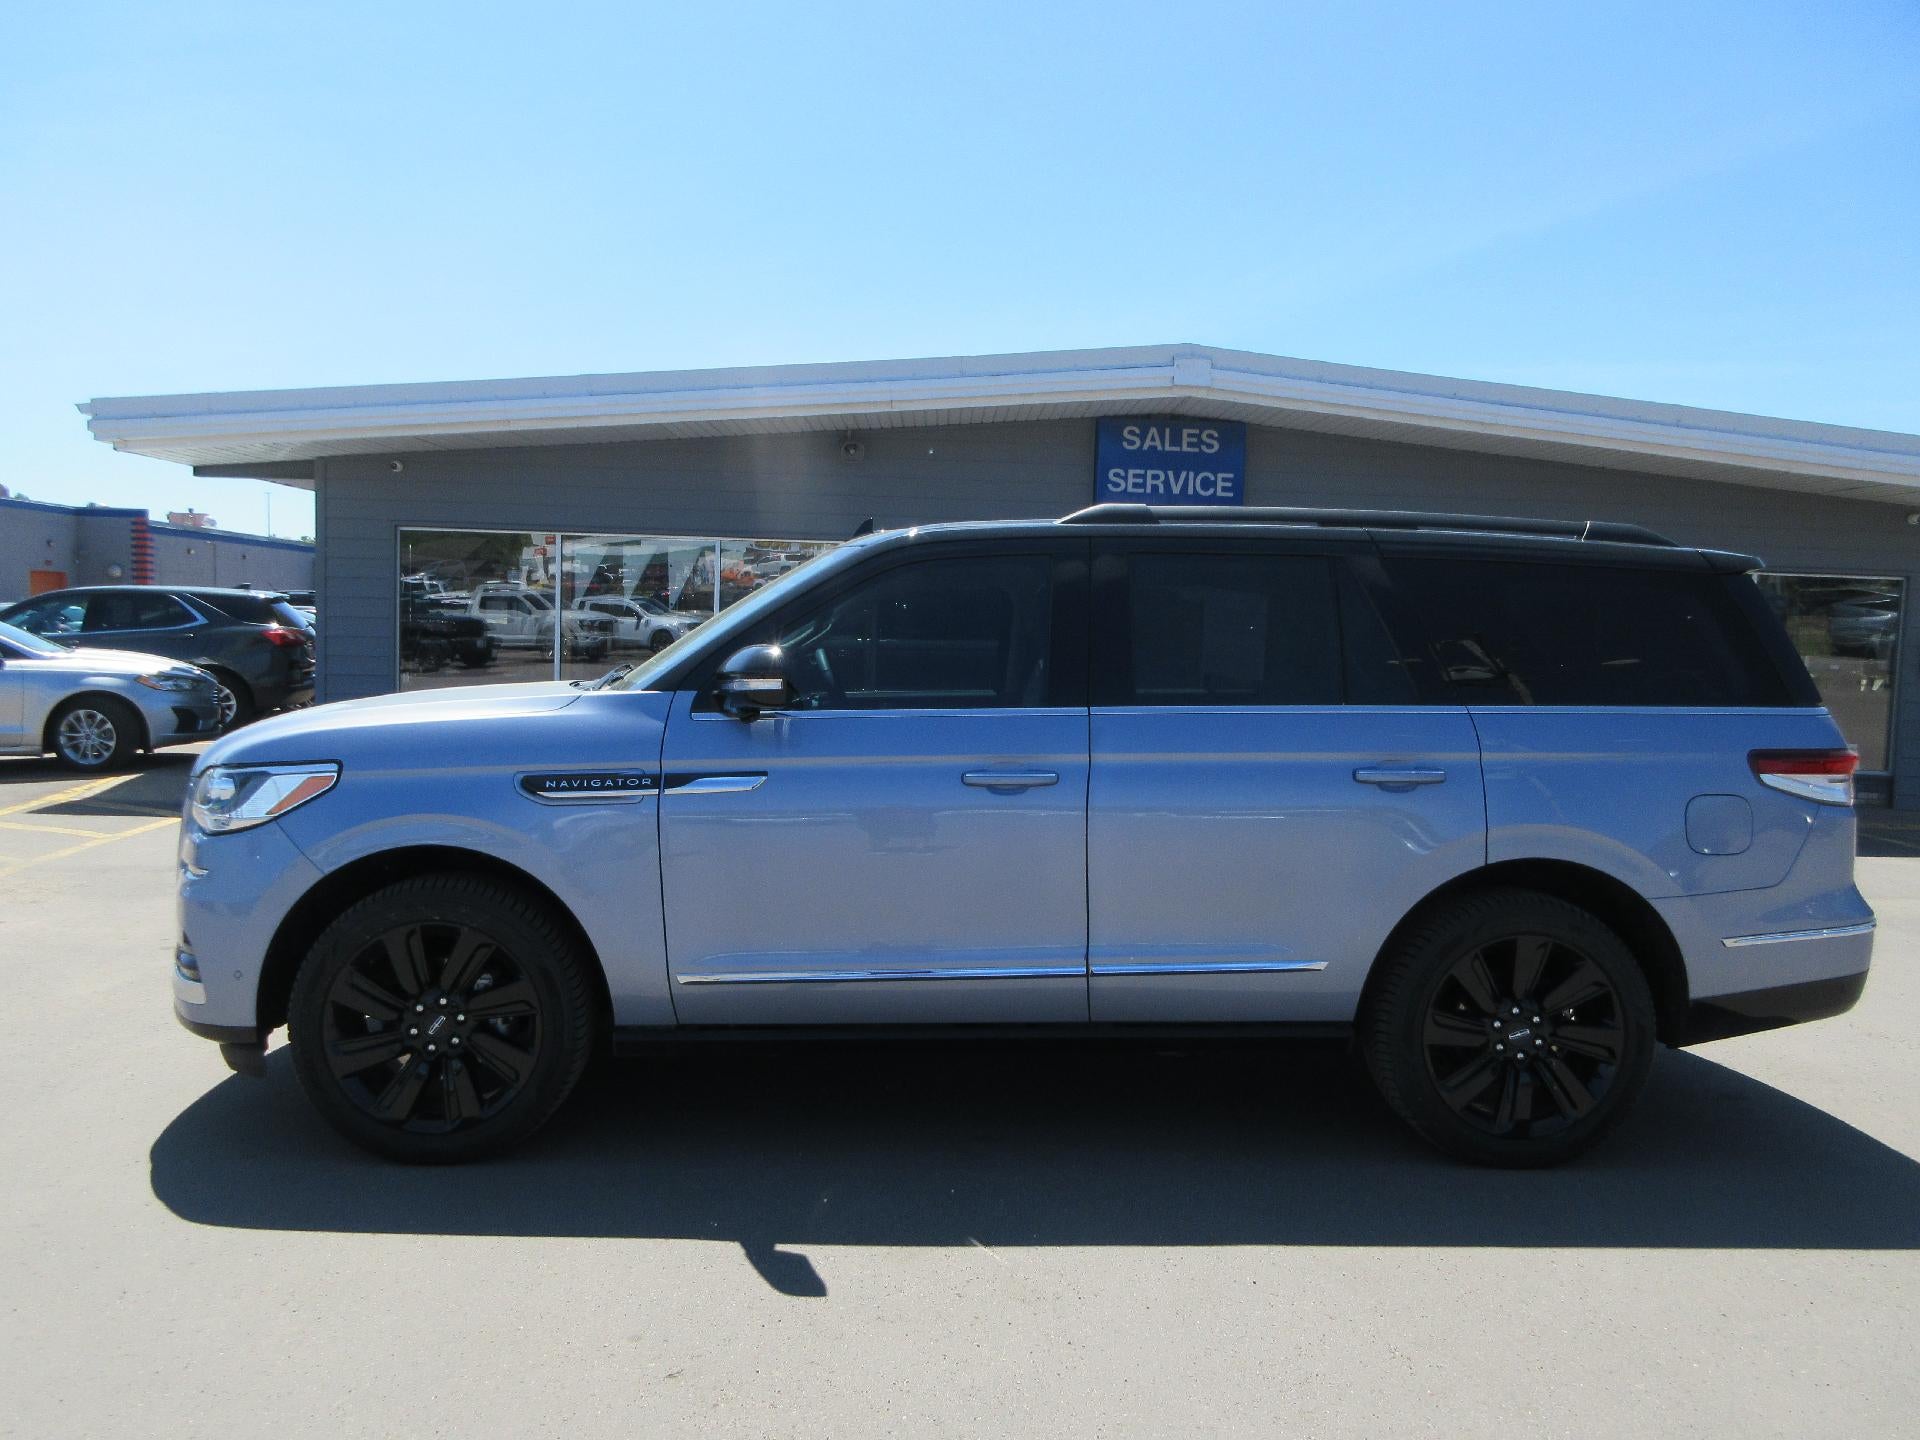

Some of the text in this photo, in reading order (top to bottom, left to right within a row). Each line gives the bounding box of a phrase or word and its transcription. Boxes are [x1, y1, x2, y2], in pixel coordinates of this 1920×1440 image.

[1122, 426, 1220, 453] SALES
[1107, 468, 1234, 497] SERVICE
[545, 778, 652, 788] NAVIGATOR
